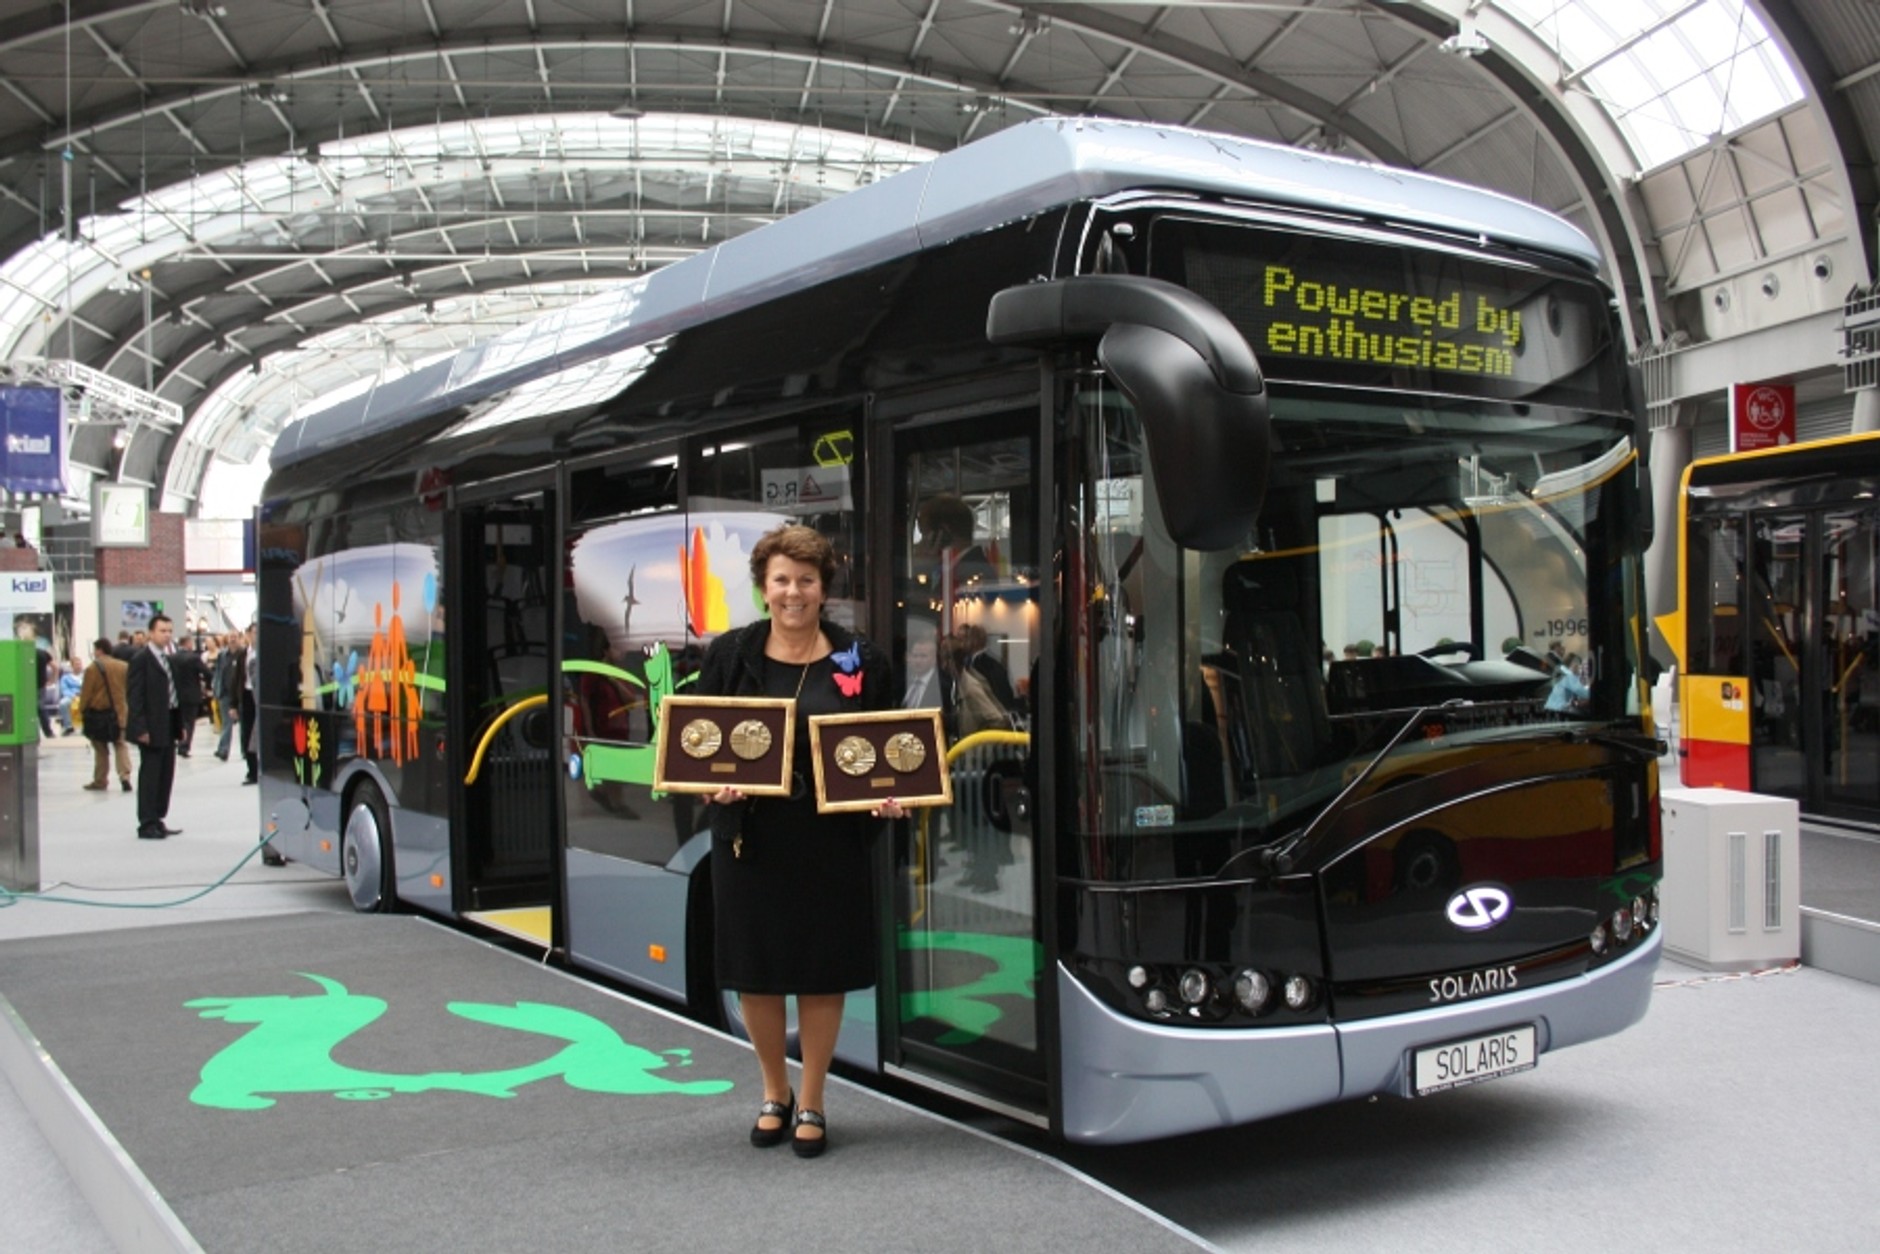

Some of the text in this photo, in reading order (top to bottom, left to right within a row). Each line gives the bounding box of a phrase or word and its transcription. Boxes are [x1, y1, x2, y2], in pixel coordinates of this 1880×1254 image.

[1263, 265, 1522, 347] Powered by
[1267, 318, 1513, 376] enthusiasm
[1757, 390, 1776, 402] WC
[12, 577, 47, 592] kiel
[1547, 618, 1588, 637] 1996
[1428, 965, 1519, 1003] SOLARIS
[1436, 1034, 1519, 1081] SOLARIS
